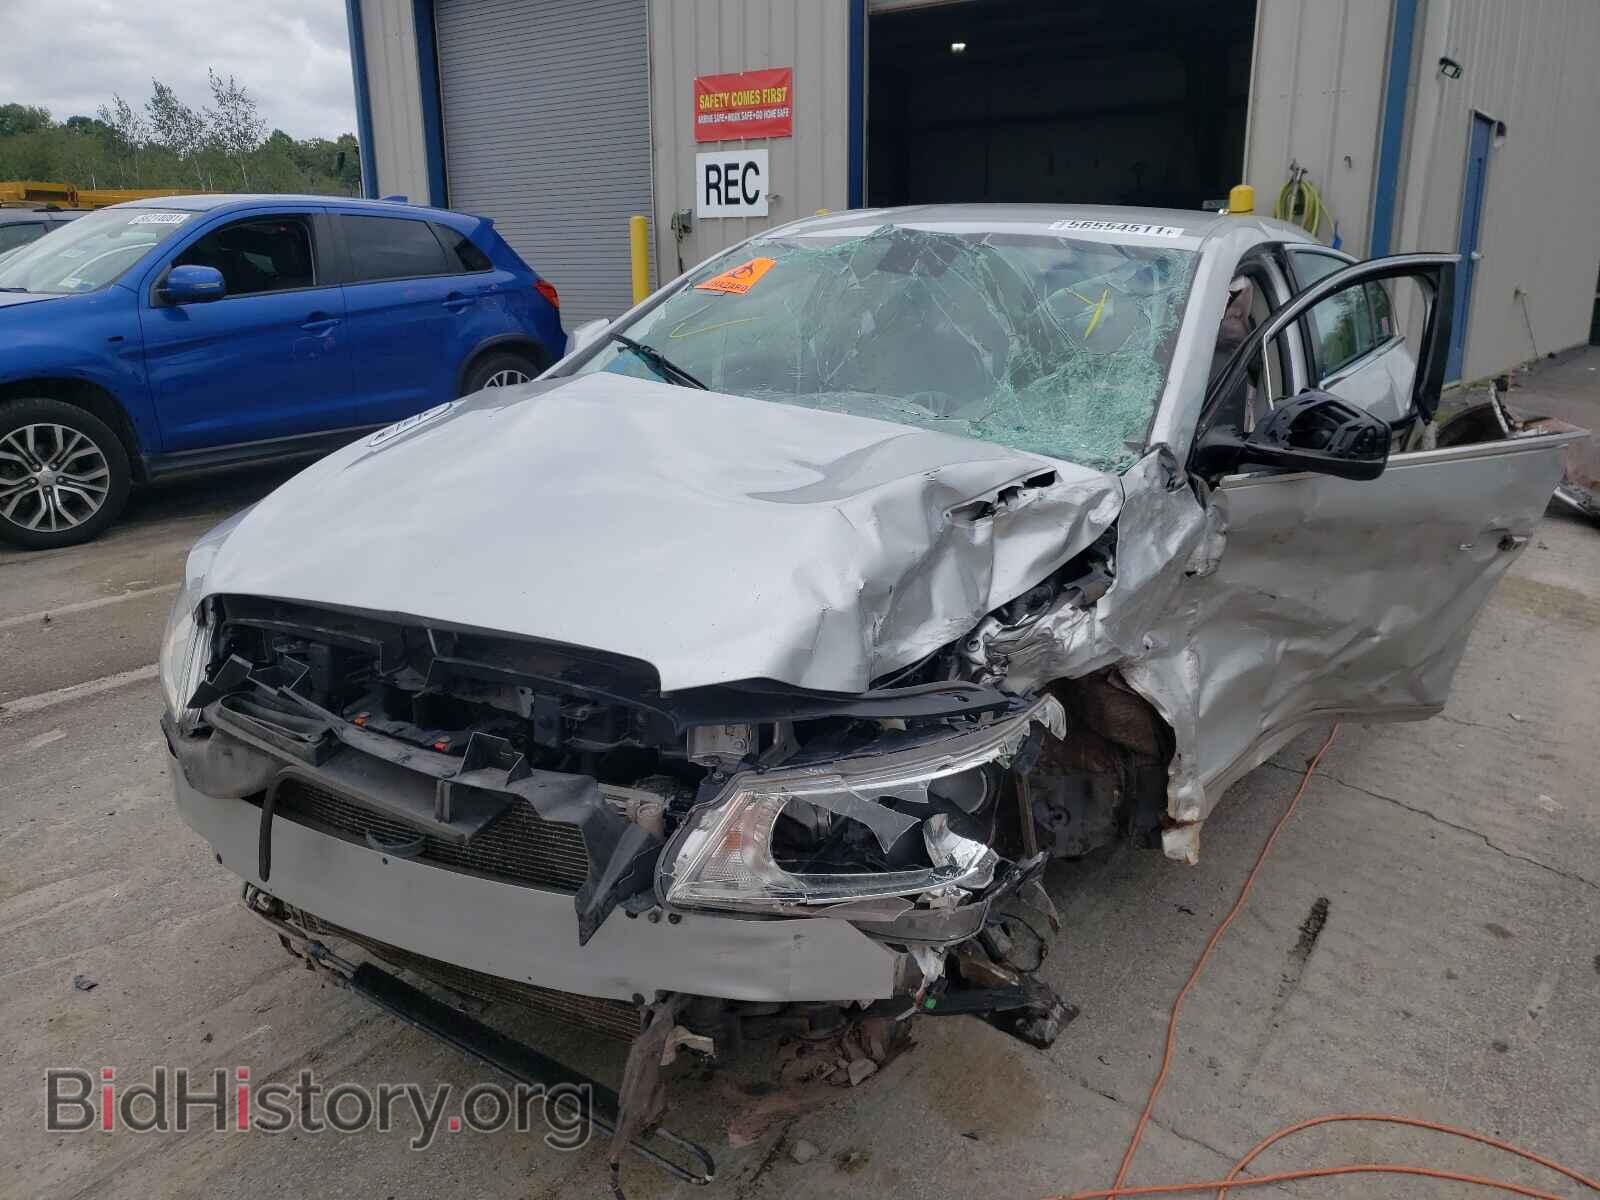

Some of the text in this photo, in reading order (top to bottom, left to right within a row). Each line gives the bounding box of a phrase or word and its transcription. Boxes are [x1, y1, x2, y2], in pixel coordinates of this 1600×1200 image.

[699, 87, 788, 109] SAFETY COMES FIRST
[705, 161, 760, 206] REC
